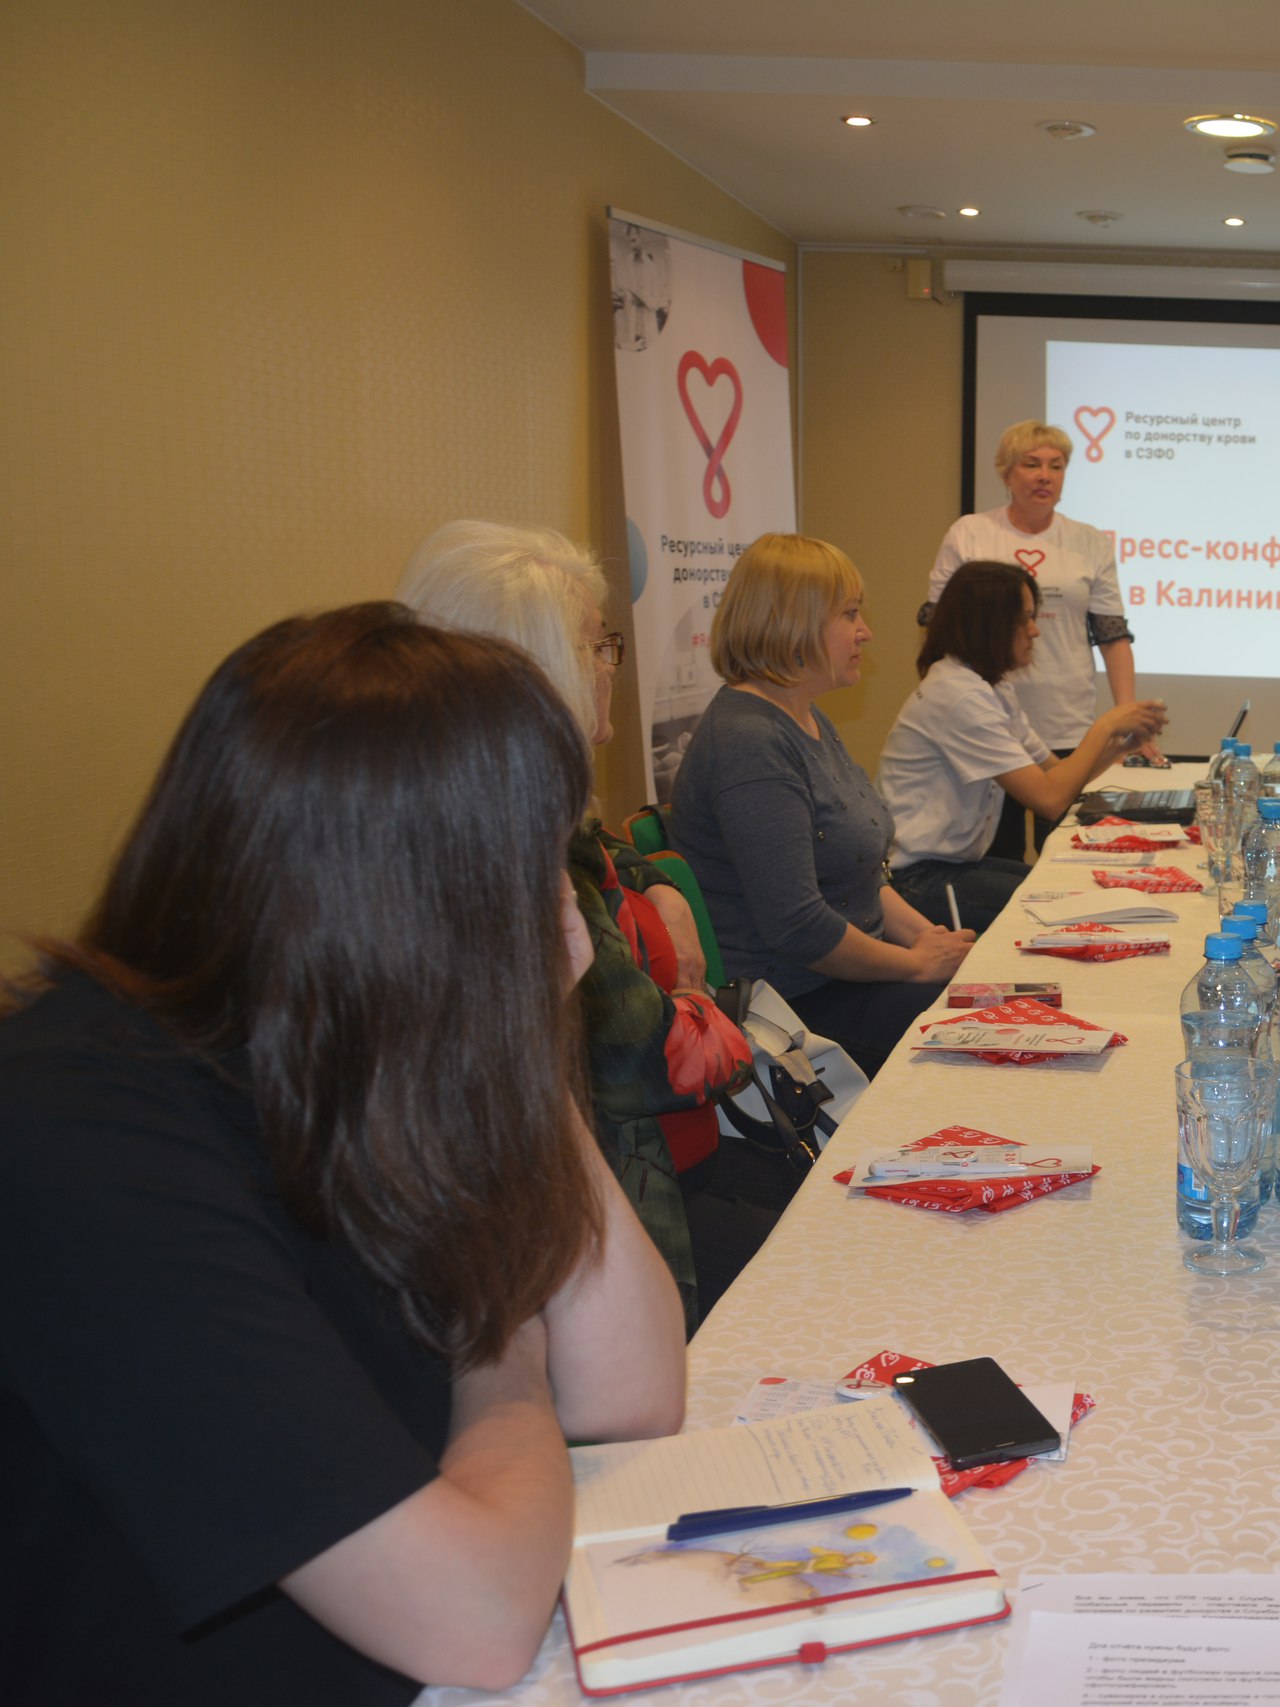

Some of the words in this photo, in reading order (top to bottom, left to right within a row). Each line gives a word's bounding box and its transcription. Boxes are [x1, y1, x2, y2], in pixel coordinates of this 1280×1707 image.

[1125, 411, 1198, 430] Ресурсный
[1201, 415, 1241, 430] центр
[1125, 431, 1141, 443] по
[1144, 432, 1213, 447] донорству
[1216, 434, 1256, 447] крови
[1125, 449, 1133, 459] в
[1136, 446, 1175, 460] СЗФО
[660, 535, 725, 557] Ресурсный
[703, 595, 710, 609] в
[1129, 585, 1146, 606] в
